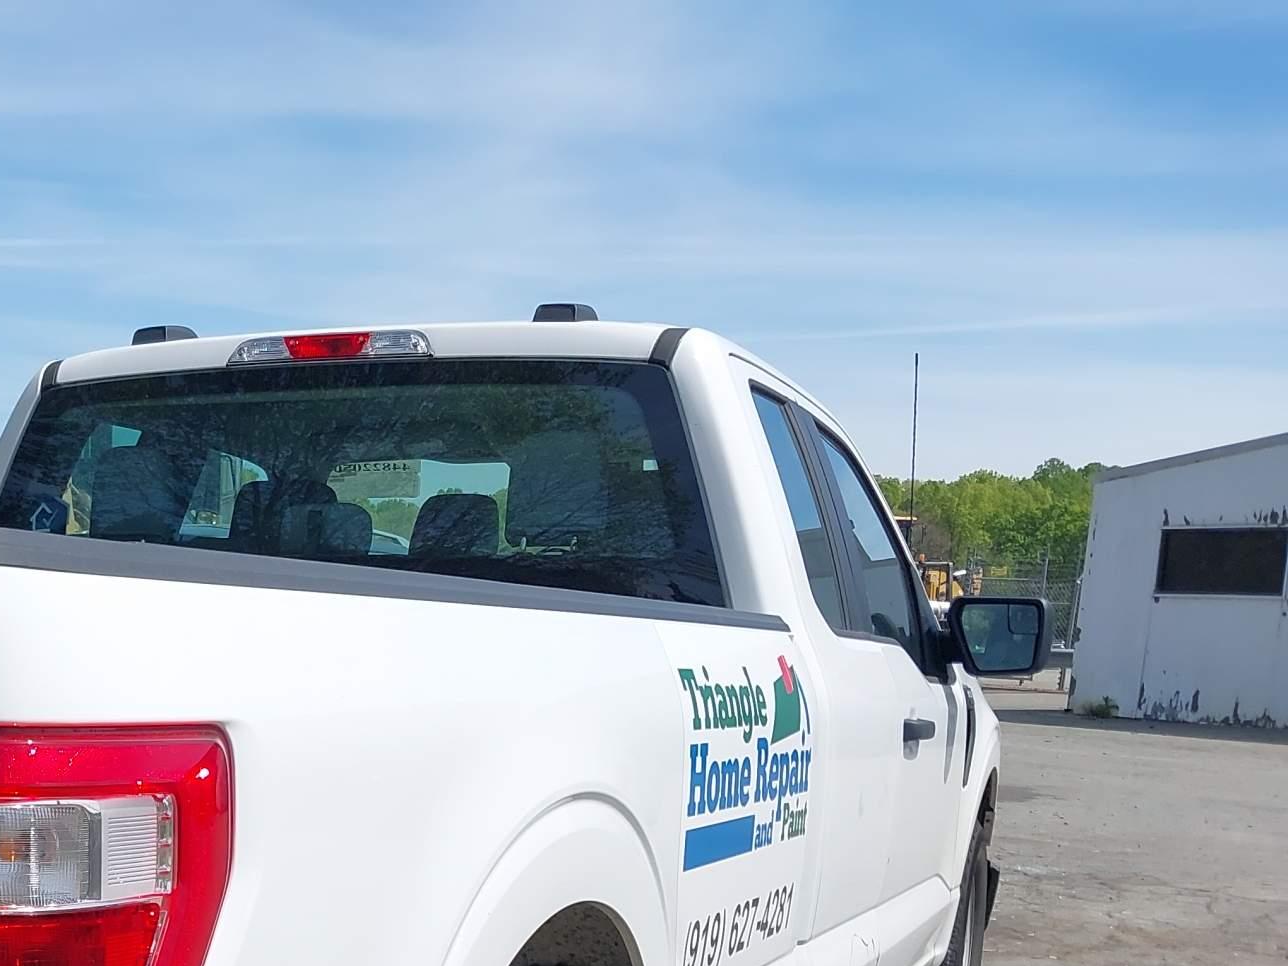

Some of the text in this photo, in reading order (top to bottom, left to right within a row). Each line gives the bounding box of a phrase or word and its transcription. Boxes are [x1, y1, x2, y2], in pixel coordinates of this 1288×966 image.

[677, 665, 768, 744] Triangle
[687, 728, 812, 822] Home Repair
[754, 798, 808, 850] and Paint
[728, 882, 795, 957] 627-4281
